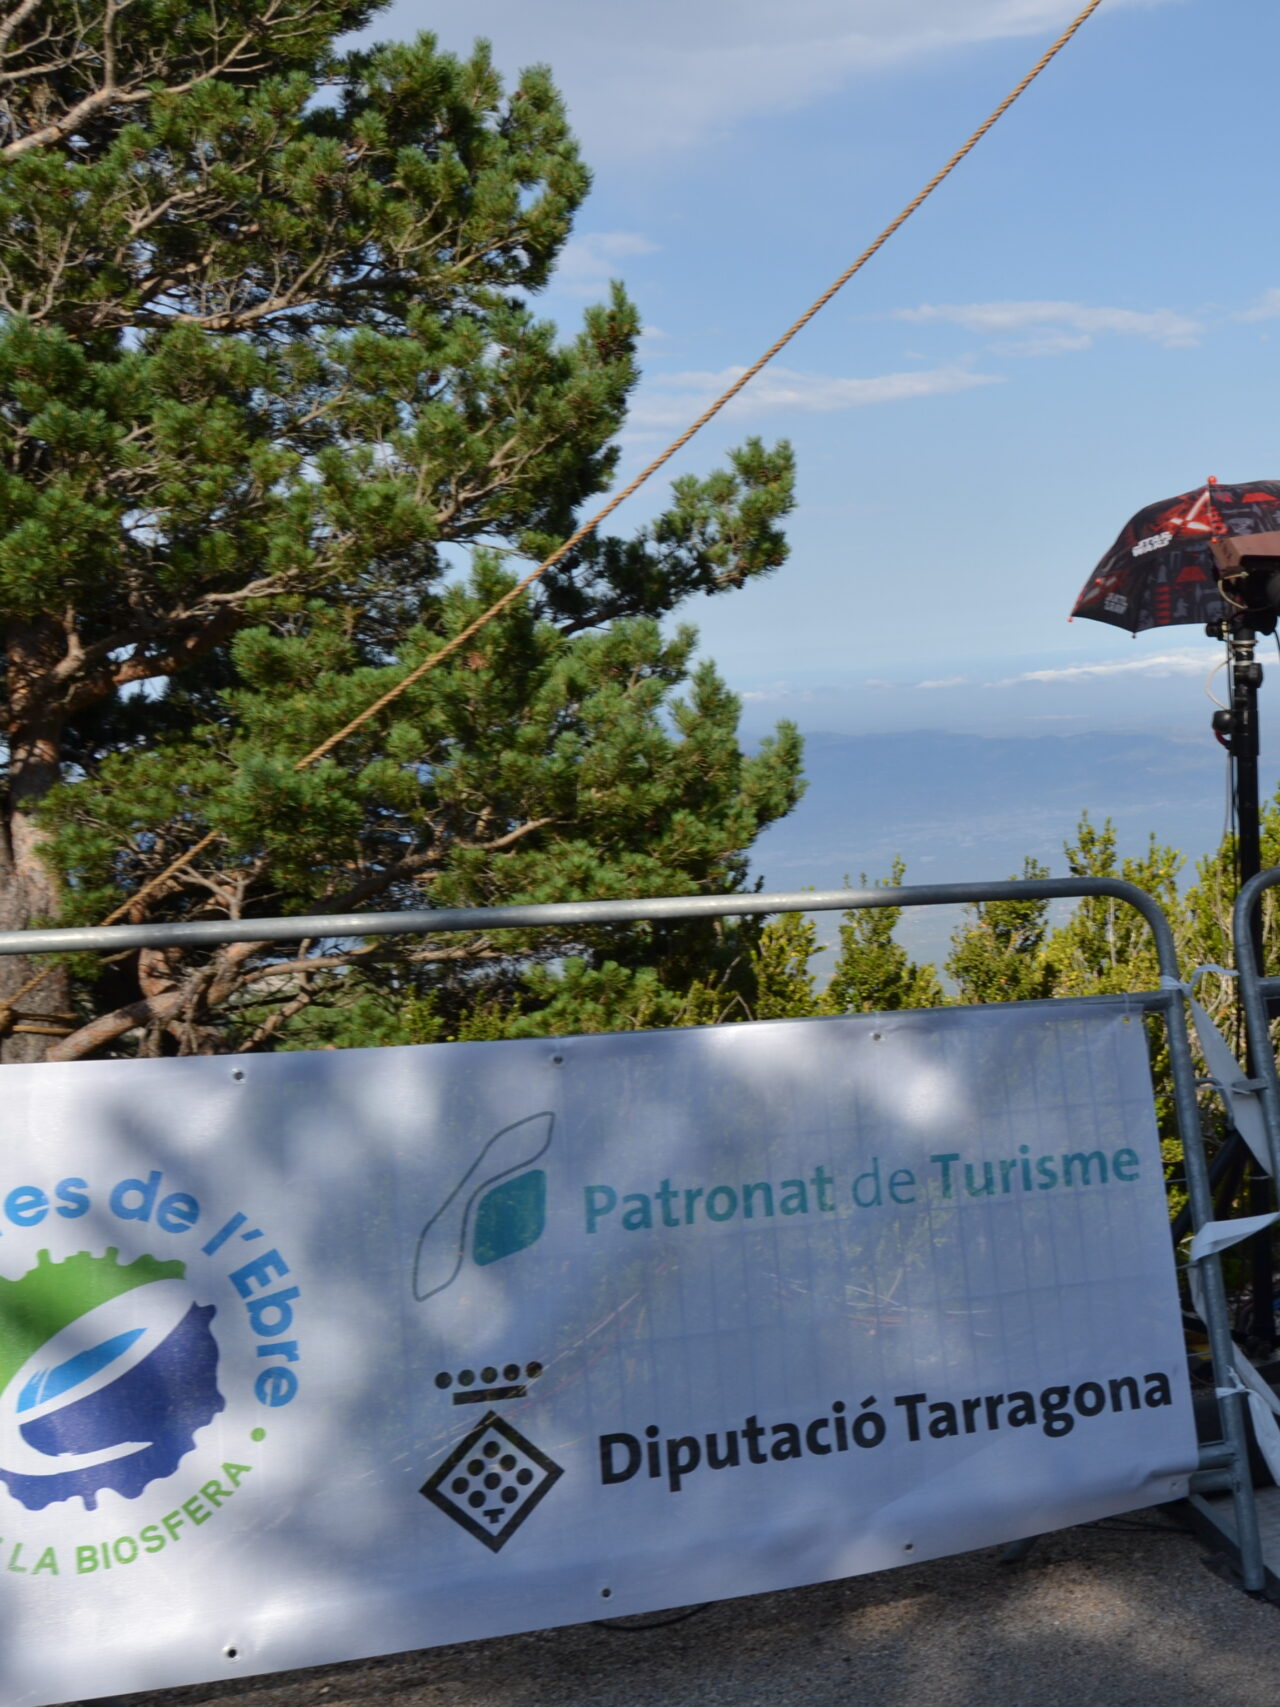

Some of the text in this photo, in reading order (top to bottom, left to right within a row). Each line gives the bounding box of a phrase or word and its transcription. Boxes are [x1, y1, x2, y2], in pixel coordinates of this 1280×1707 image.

[584, 1143, 1141, 1235] Patronat de Turisme
[109, 1170, 201, 1234] de
[201, 1211, 301, 1408] l'Ebre
[600, 1370, 1173, 1492] Diputació Tarragona
[7, 1461, 253, 1576] LA BIOSFERA
